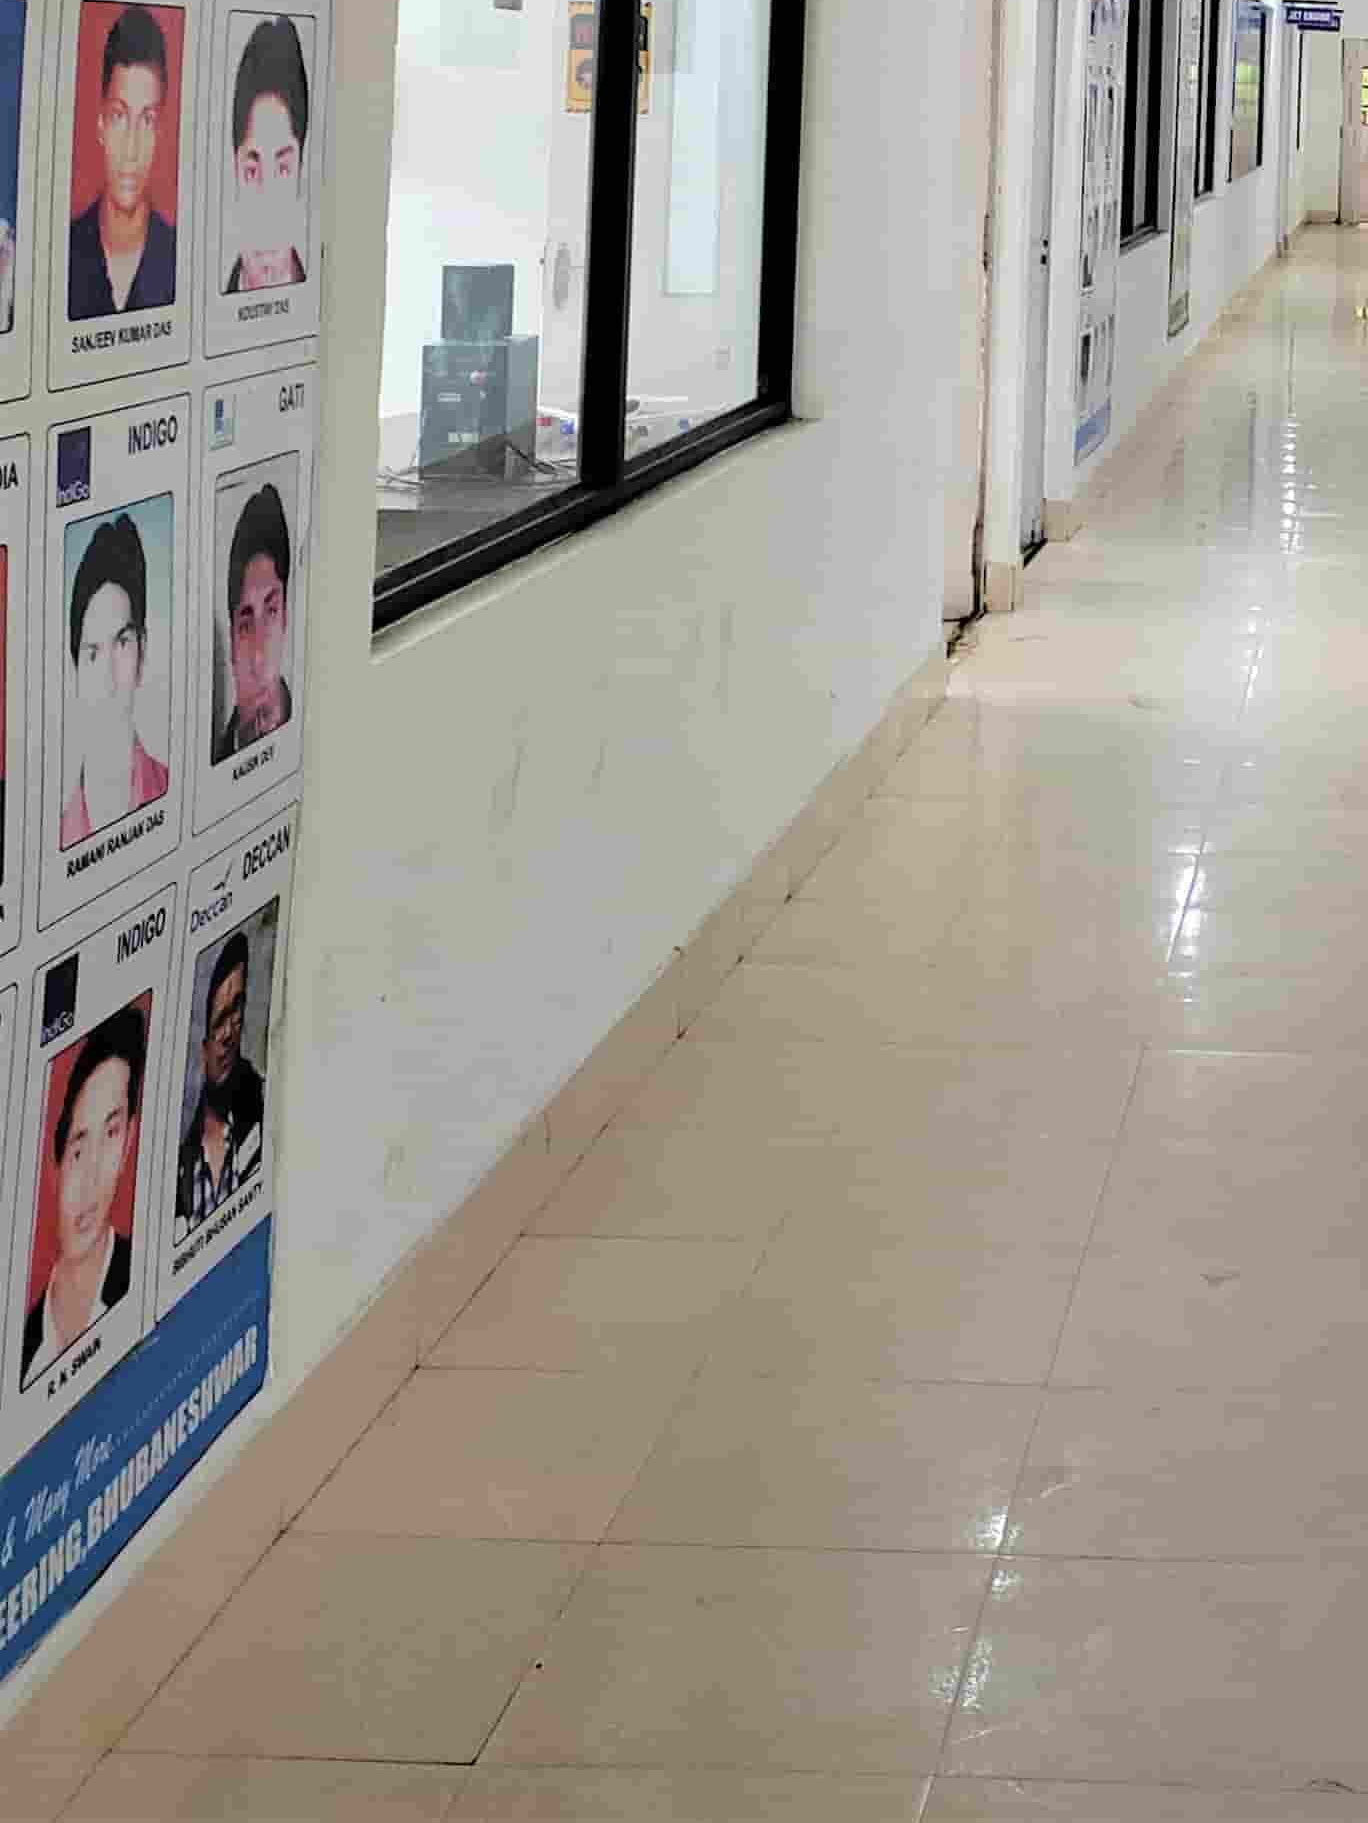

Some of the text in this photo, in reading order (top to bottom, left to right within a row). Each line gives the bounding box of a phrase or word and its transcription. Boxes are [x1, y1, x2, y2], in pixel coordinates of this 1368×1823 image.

[128, 415, 179, 455] INDIGO
[243, 825, 290, 880] DECCAN
[116, 908, 166, 964] INDIGO
